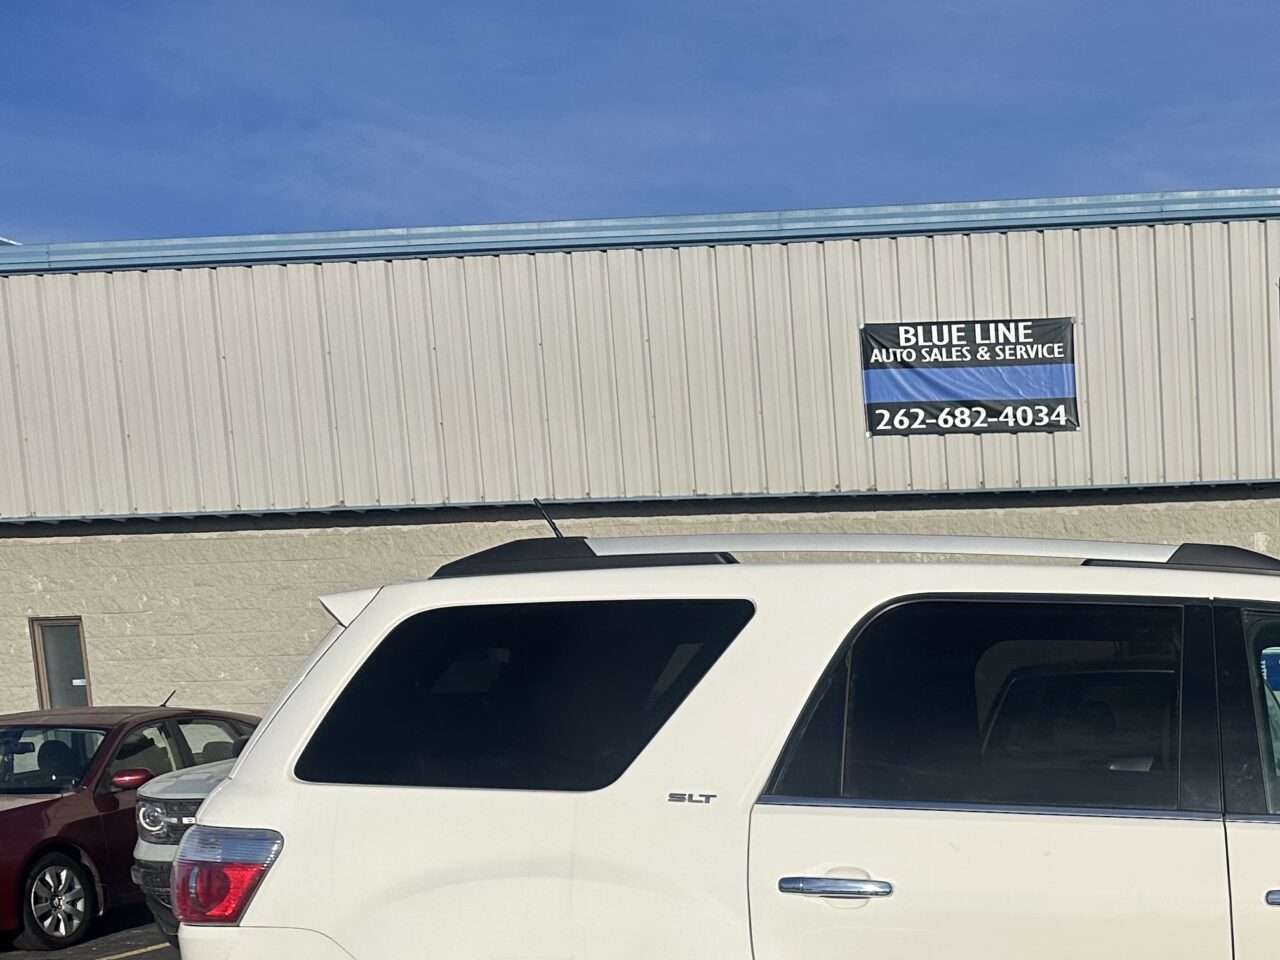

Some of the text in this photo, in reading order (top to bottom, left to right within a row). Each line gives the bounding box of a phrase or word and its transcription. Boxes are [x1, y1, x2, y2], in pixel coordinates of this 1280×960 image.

[898, 321, 1034, 347] BLUE LINE
[870, 343, 1065, 363] AUTO SALES & SERVICE
[874, 404, 1068, 430] 262-682-4034
[667, 792, 718, 804] SLT
